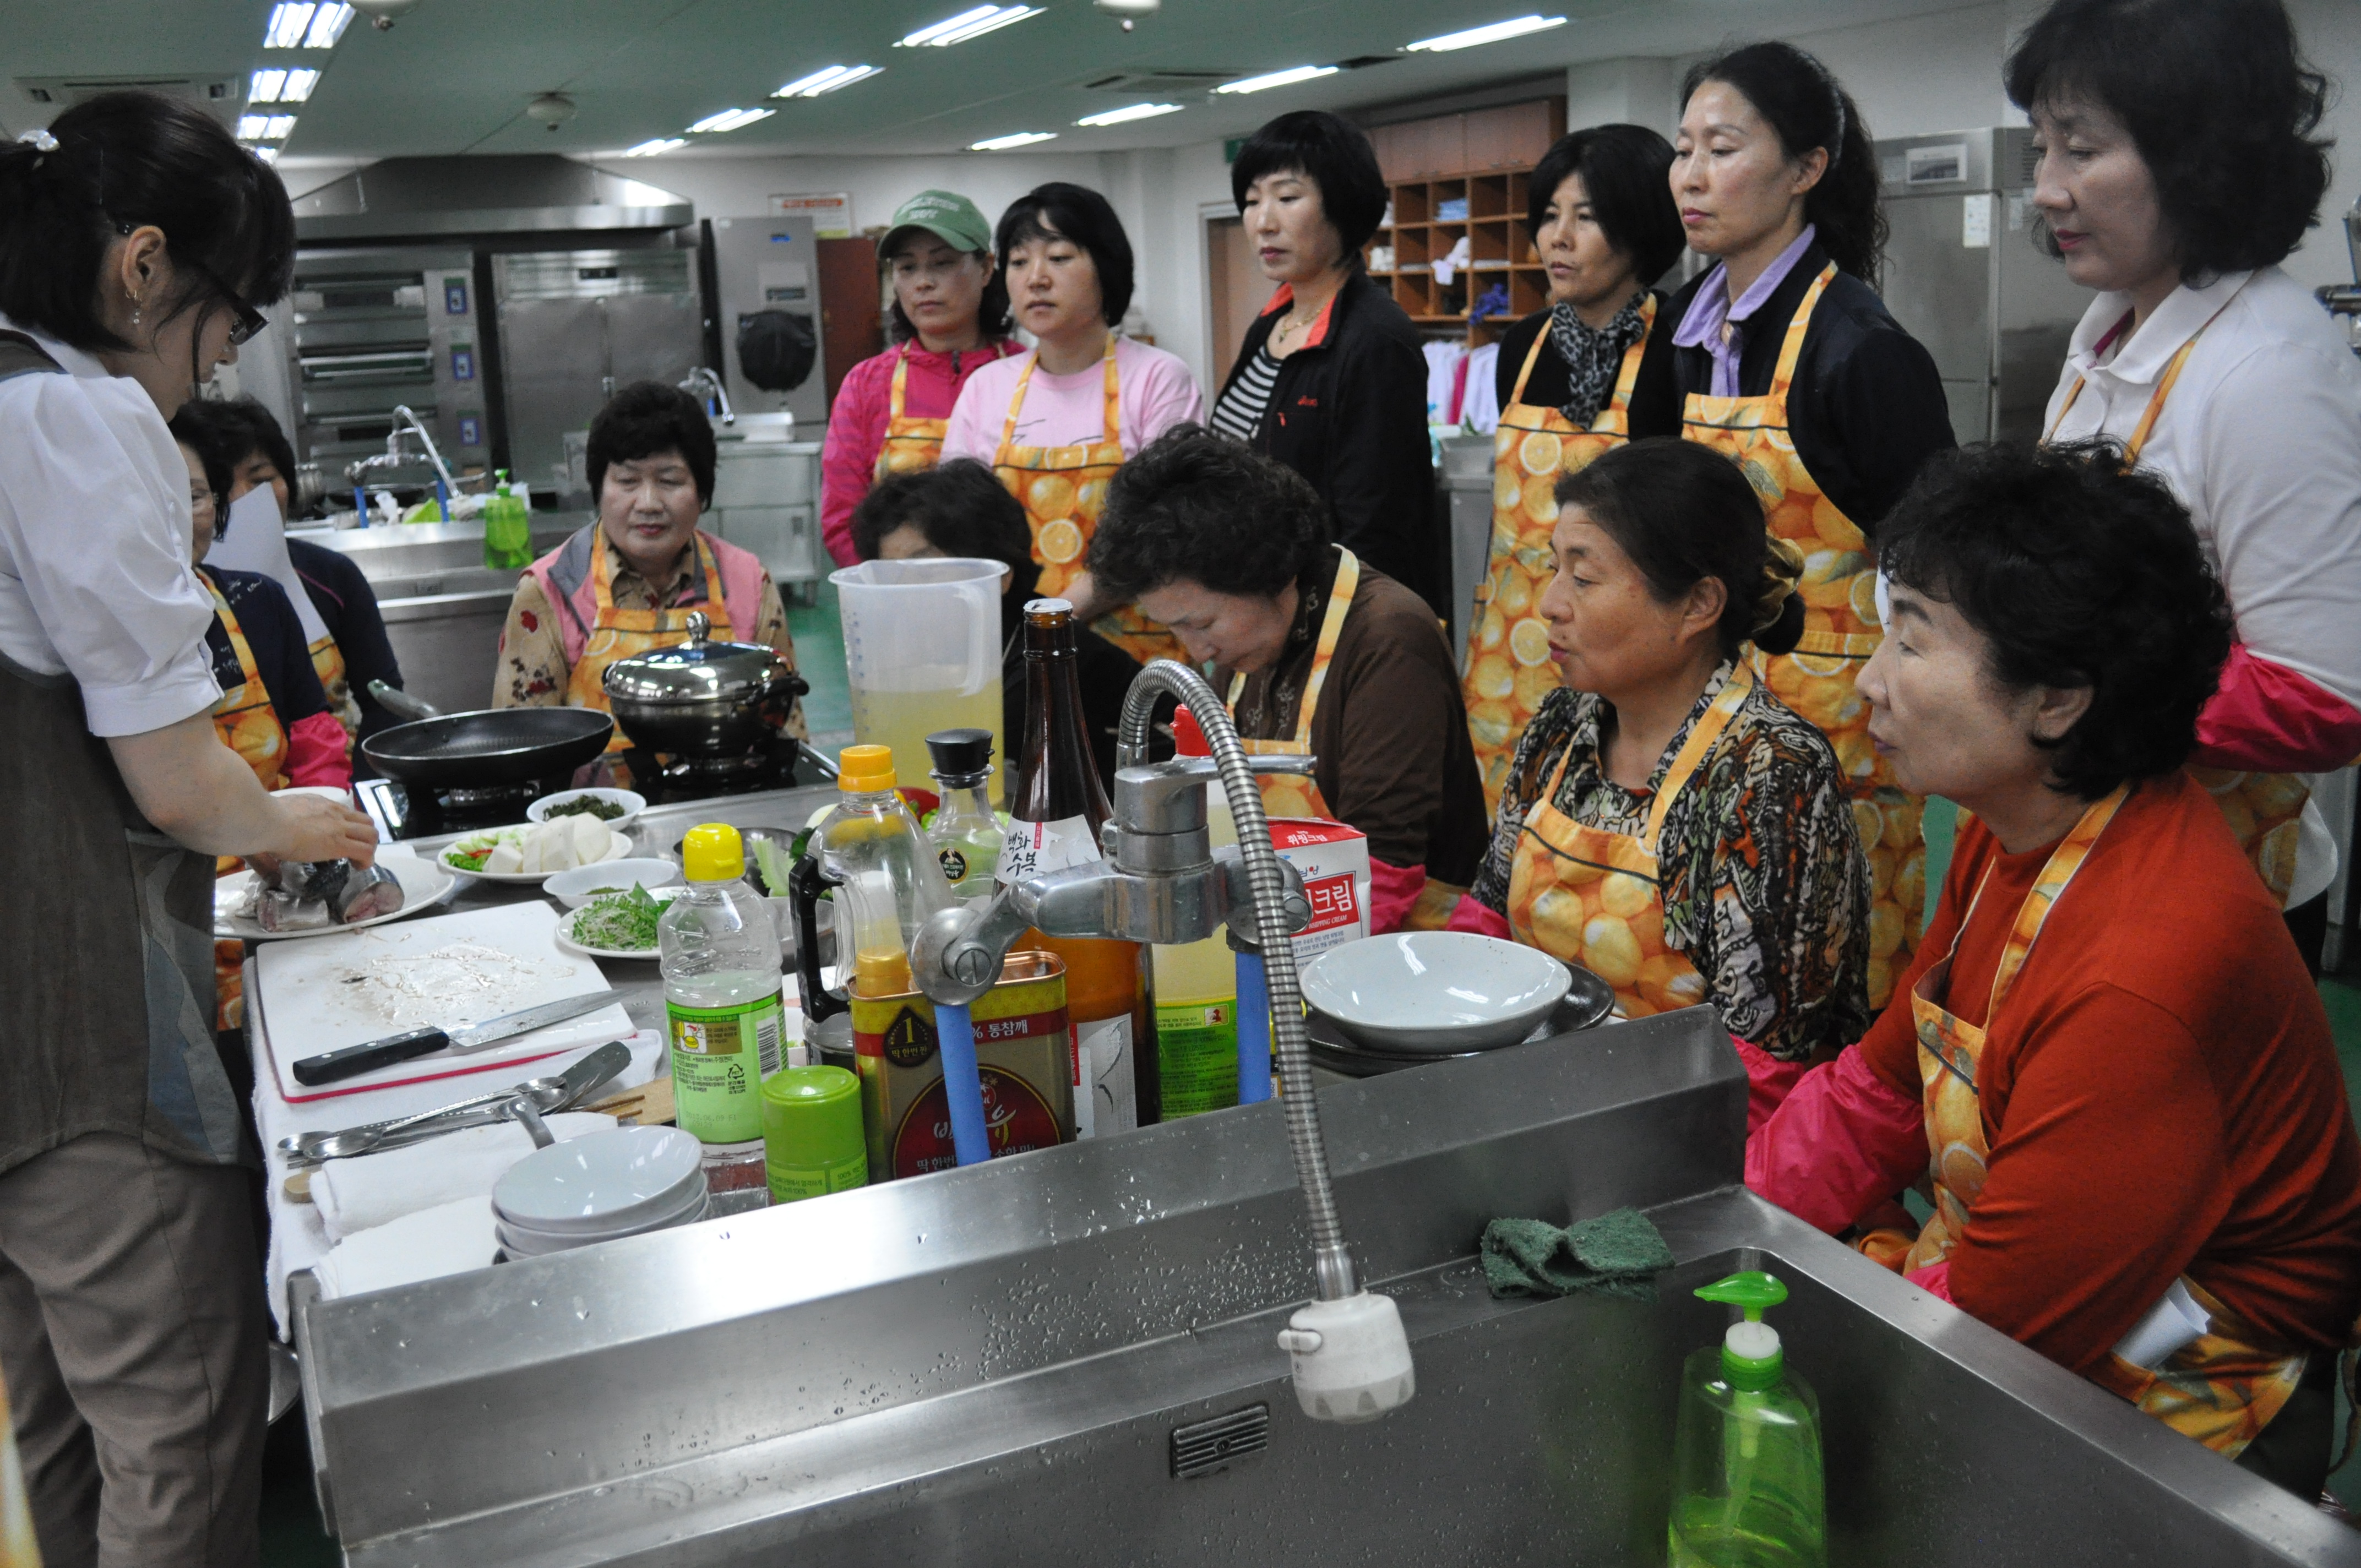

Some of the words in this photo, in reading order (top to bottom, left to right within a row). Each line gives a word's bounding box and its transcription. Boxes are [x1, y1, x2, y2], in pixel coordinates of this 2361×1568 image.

[1008, 830, 1031, 853] 백화
[1287, 834, 1328, 845] 휘핑크림
[1007, 851, 1037, 877] 수복
[1298, 865, 1319, 878] 남양
[1331, 914, 1347, 924] CREAM
[903, 1017, 915, 1044] 1
[988, 1020, 1028, 1038] 통참깨
